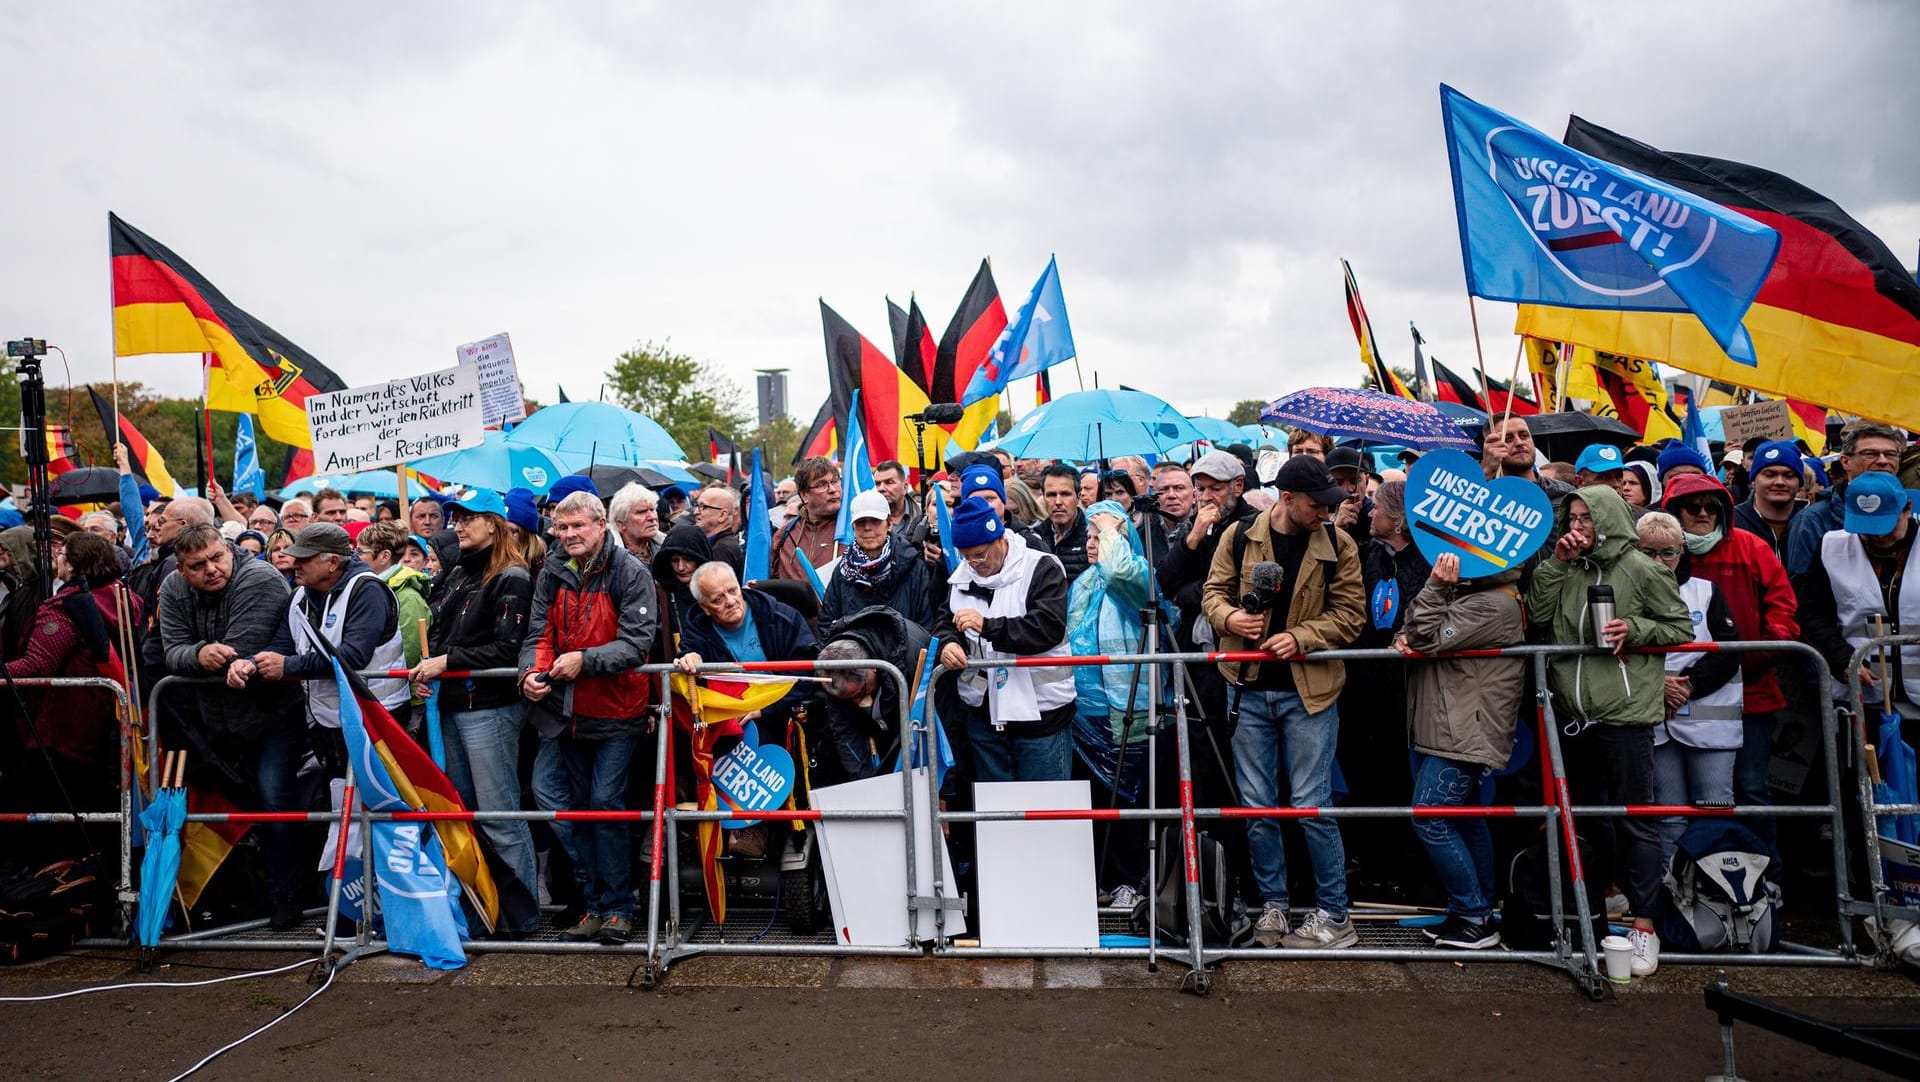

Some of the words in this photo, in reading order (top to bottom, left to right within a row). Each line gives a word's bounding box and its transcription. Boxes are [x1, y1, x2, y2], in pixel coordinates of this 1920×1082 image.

[1601, 181, 1691, 230] LAND
[478, 357, 510, 371] sequenz
[310, 398, 326, 414] Im
[331, 390, 380, 409] Namen
[383, 384, 407, 400] des
[479, 375, 514, 390] mpetenz
[312, 410, 337, 426] und
[340, 408, 364, 422] der
[366, 390, 440, 415] Wirtschaft
[397, 411, 417, 425] den
[378, 427, 403, 441] der
[1429, 467, 1490, 508] UNSER
[1488, 494, 1543, 530] LAND
[1412, 488, 1530, 558] ZUERST!
[712, 757, 773, 812] UERST!
[731, 741, 757, 768] SER
[751, 758, 786, 793] LAND
